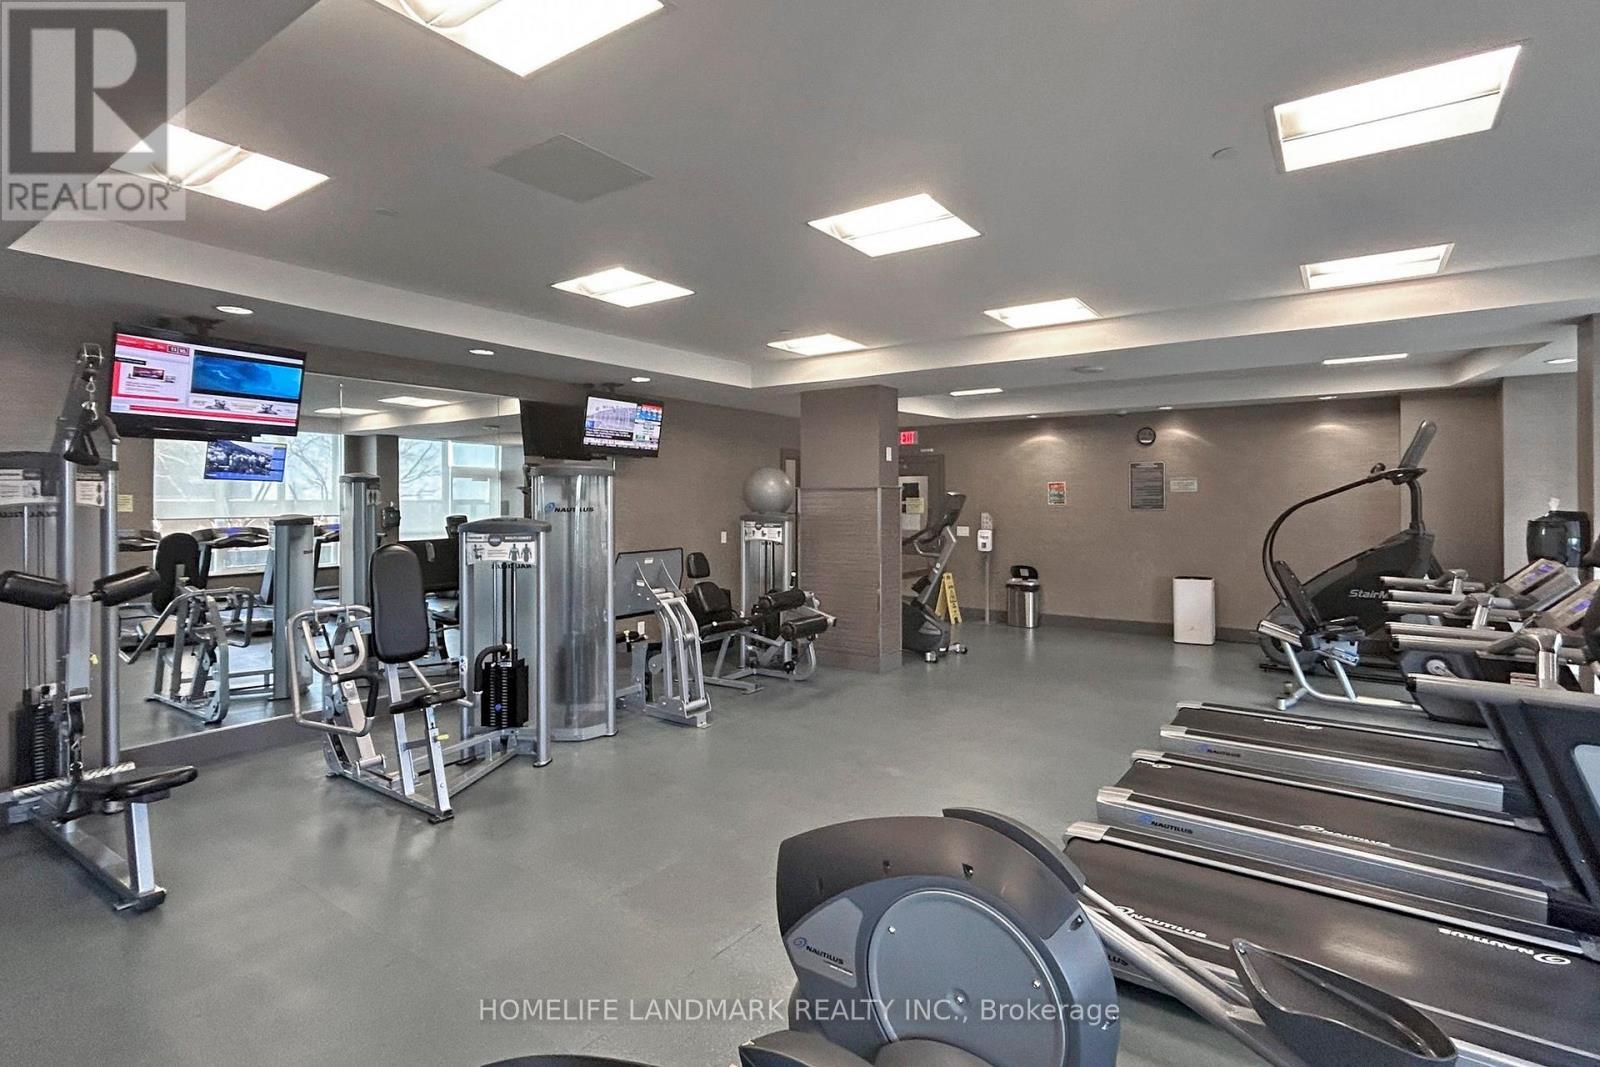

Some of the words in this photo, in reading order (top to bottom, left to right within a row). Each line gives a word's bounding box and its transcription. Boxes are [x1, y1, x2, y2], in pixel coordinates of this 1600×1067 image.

[1349, 589, 1389, 599] StairM
[1151, 820, 1193, 835] NAUTILUS
[1131, 912, 1207, 939] NAUTILUS
[806, 945, 844, 965] NAUTILUS
